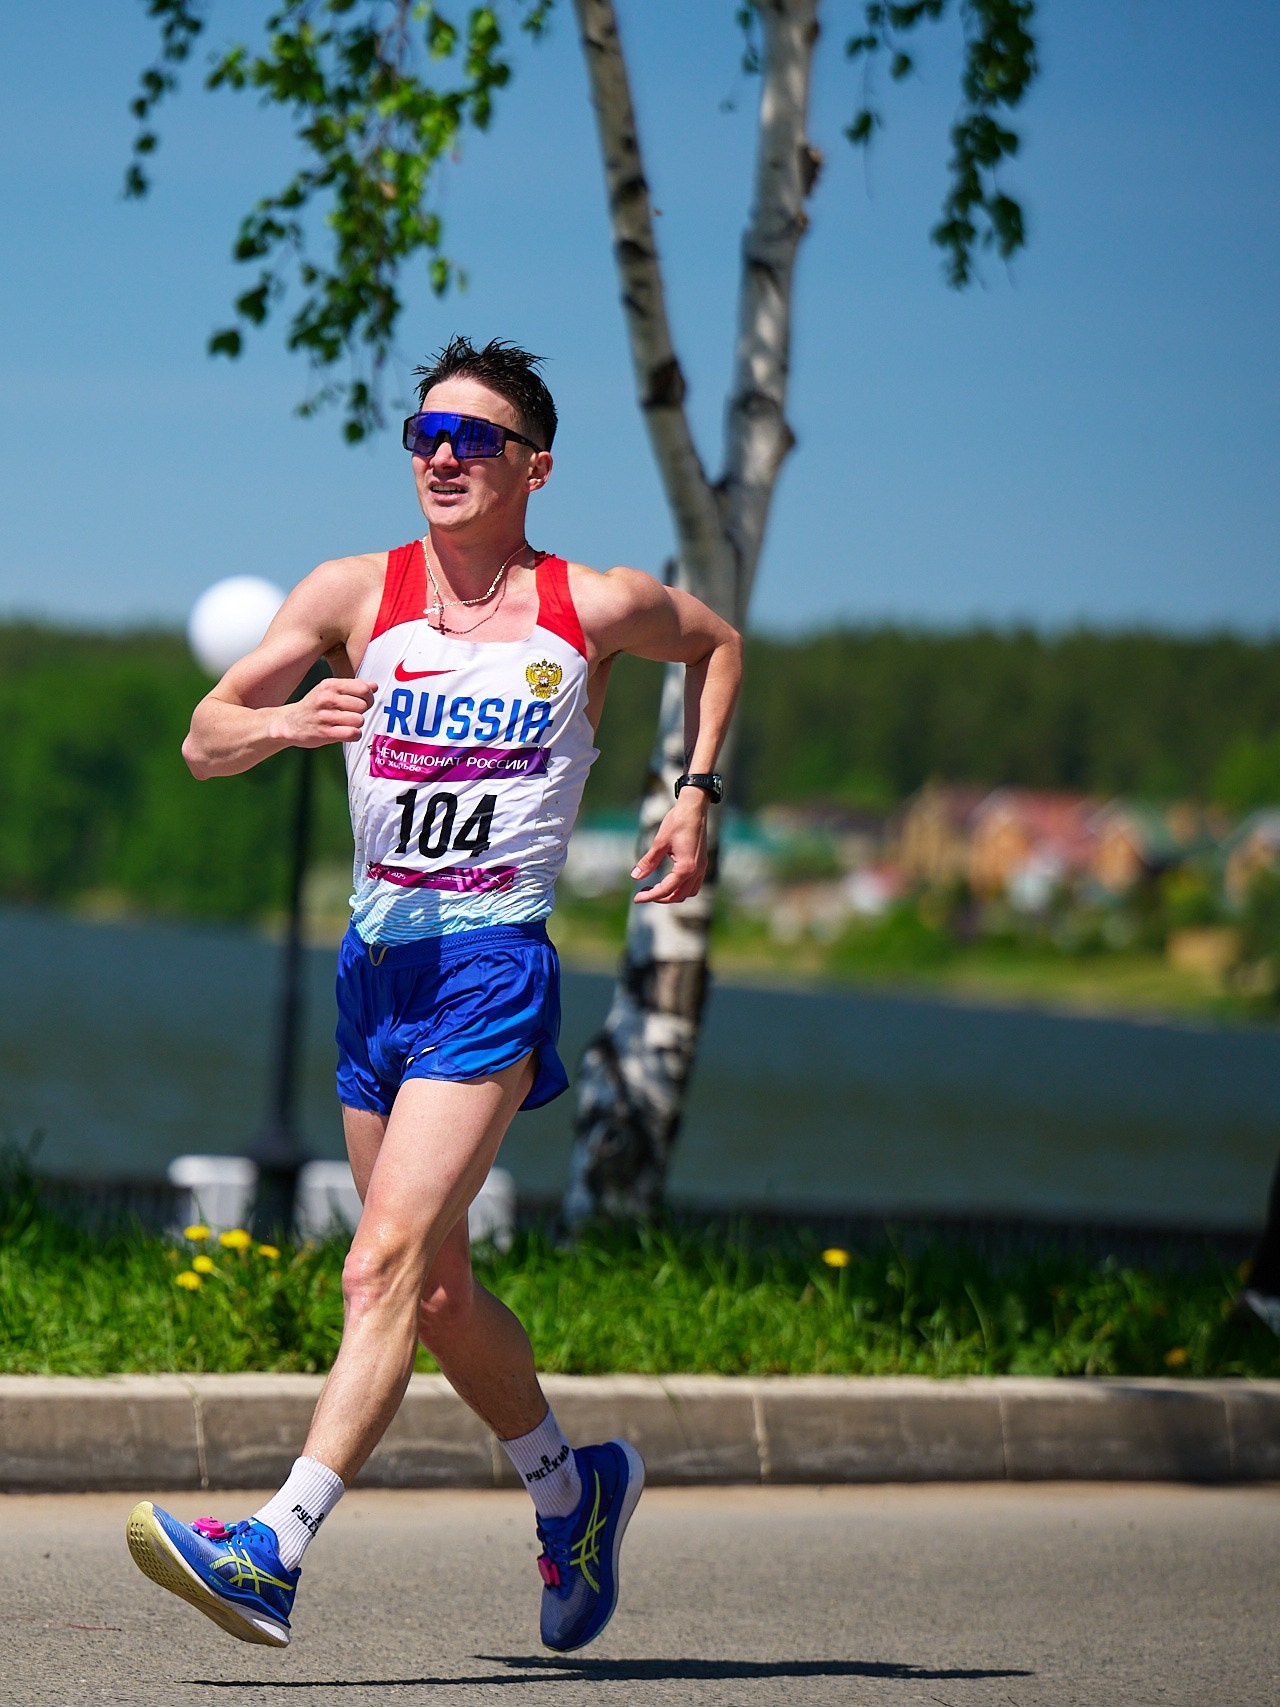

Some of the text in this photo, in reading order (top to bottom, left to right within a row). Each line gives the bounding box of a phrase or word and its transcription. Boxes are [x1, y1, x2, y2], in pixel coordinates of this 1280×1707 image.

[384, 687, 554, 744] RUSSIA
[376, 746, 529, 771] ЧЕМПИОНАТ РОССИИ
[395, 788, 498, 859] 104
